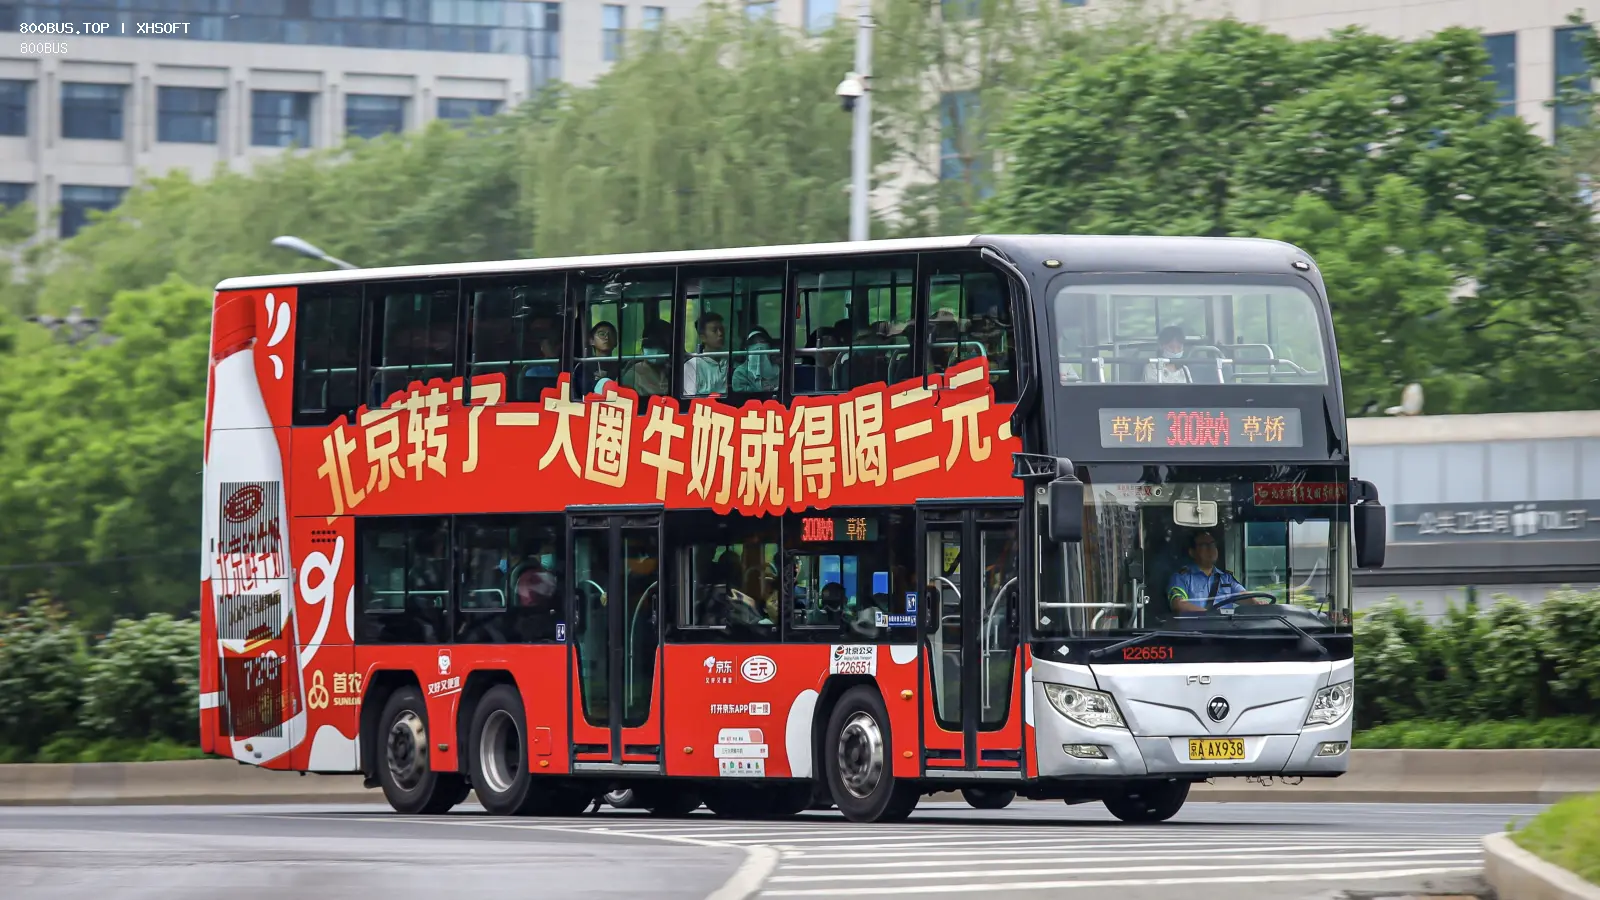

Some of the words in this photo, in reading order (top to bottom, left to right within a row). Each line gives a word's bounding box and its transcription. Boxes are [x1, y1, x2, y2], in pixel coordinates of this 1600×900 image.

[1110, 415, 1156, 443] 草桥
[1166, 411, 1230, 447] 300快内
[1240, 415, 1286, 443] 草桥
[846, 517, 867, 541] 草桥
[845, 646, 873, 655] 北京公交
[1122, 646, 1173, 660] 1226551
[715, 661, 732, 674] 京东
[749, 662, 768, 676] 三元
[835, 661, 871, 675] 1226551
[332, 671, 362, 694] 首农
